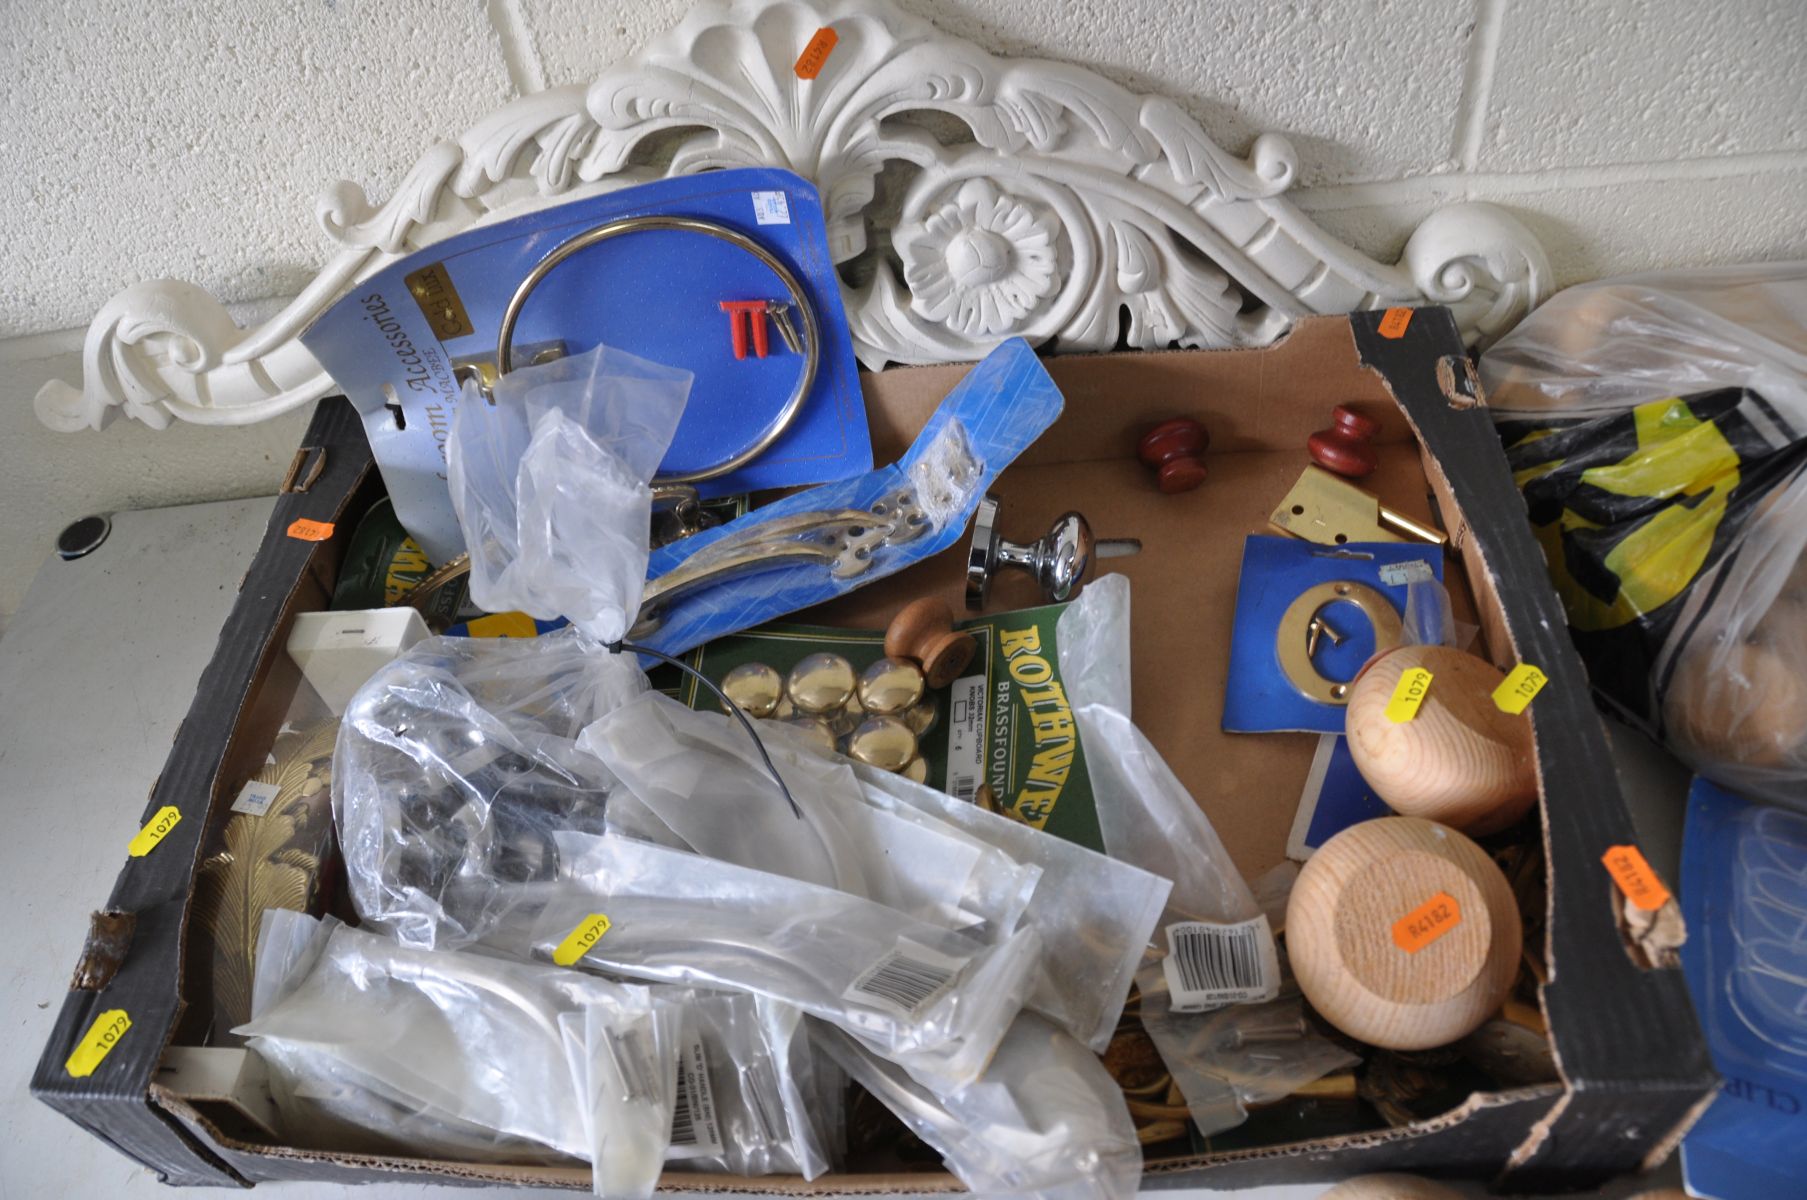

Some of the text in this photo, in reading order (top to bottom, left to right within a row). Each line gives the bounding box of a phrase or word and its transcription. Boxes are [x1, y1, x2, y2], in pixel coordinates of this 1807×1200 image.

[361, 293, 437, 395] Accessories
[1404, 672, 1430, 703] 1079
[1514, 671, 1541, 699] 1079
[975, 684, 985, 765] VICTORIAN CUPBOARD
[991, 681, 1011, 806] BRASSFOUND
[150, 811, 177, 839] 1079
[577, 919, 607, 948] 1079
[1408, 903, 1452, 939] R4182
[96, 1016, 127, 1049] 1079
